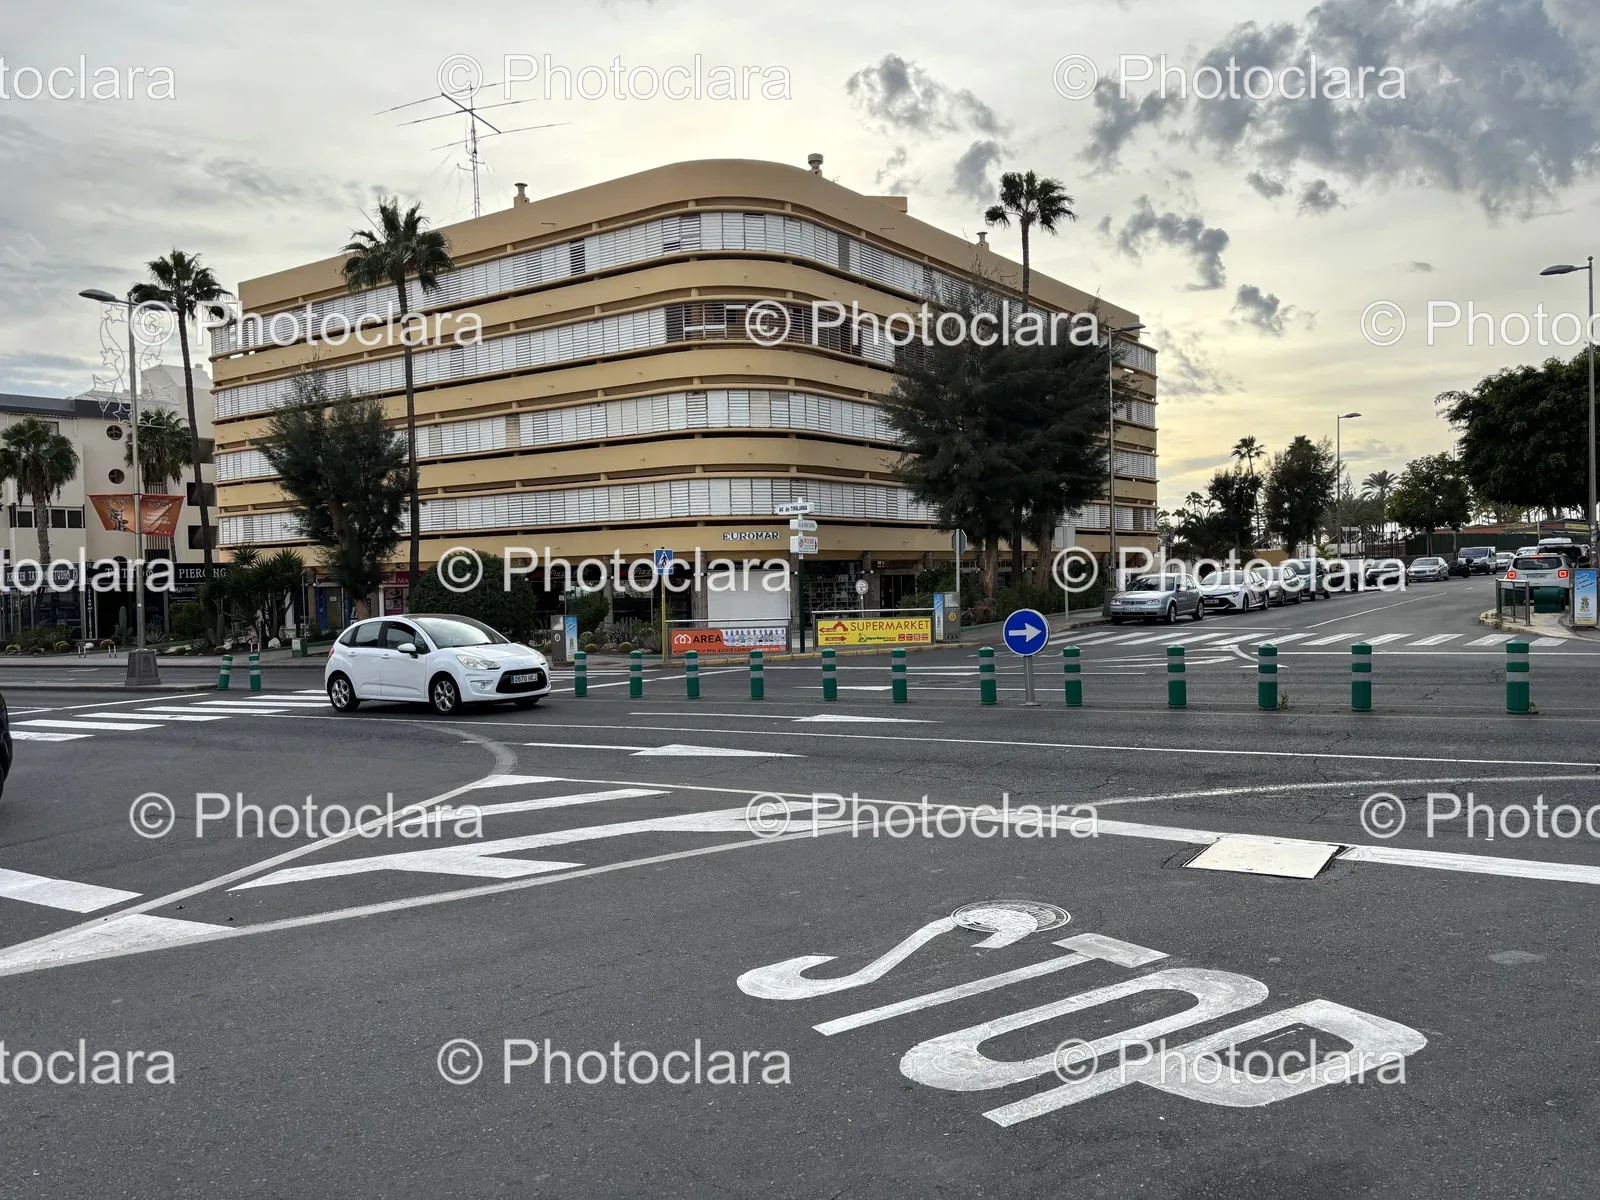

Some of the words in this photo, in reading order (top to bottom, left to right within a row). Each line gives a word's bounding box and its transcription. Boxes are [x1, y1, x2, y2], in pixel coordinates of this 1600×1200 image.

[722, 531, 780, 540] EUROMAR
[105, 567, 154, 579] TATTO
[178, 567, 227, 579] PIERCNG
[850, 620, 930, 632] SUPERMARKET
[693, 634, 722, 643] AREA
[736, 901, 1427, 1128] STOP
